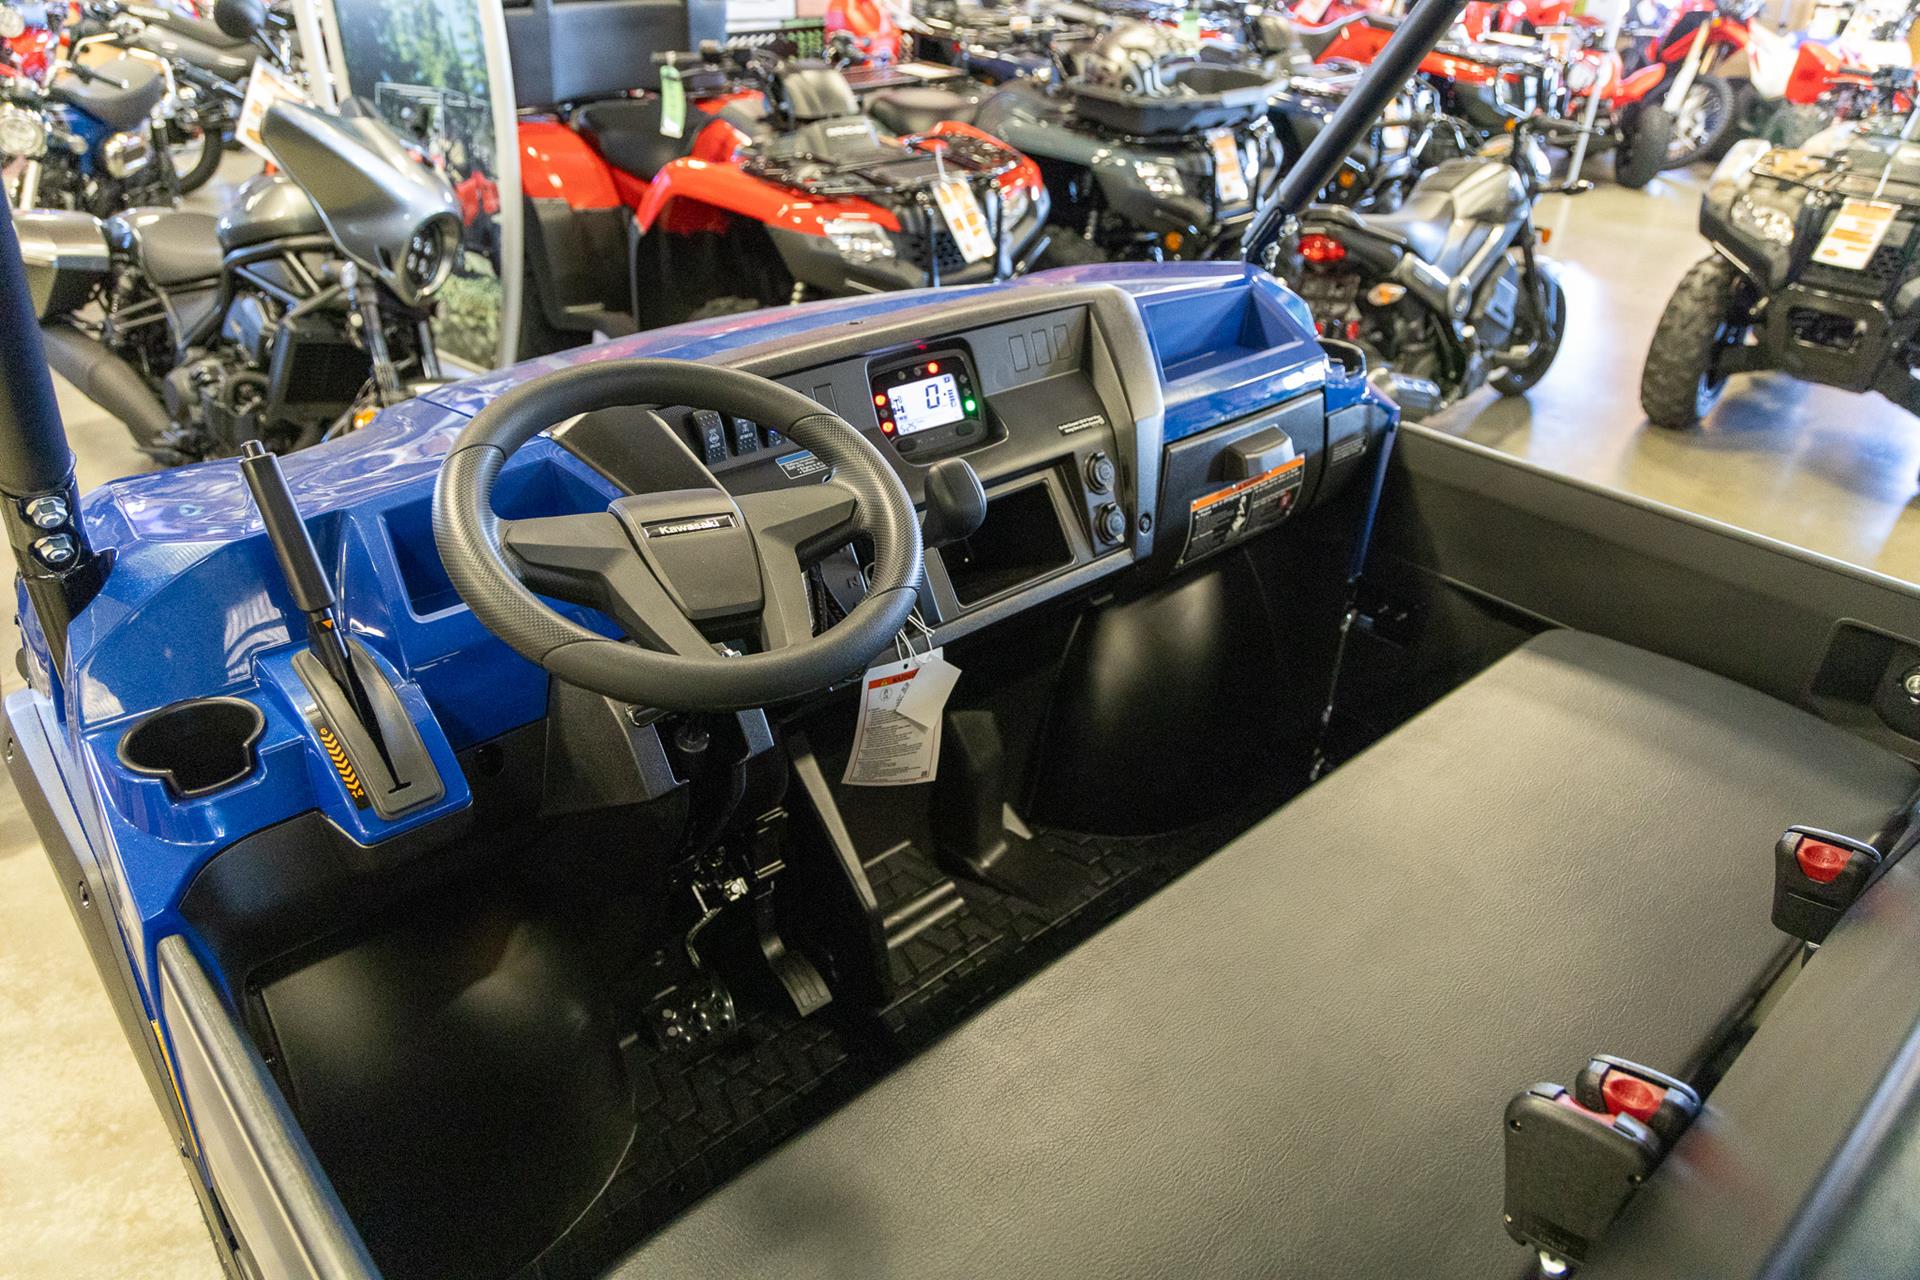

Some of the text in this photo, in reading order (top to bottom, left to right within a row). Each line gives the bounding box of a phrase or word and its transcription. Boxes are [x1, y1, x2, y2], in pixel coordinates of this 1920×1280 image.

[925, 384, 940, 409] 0
[659, 519, 720, 535] Kawasaki
[351, 788, 364, 799] 14
